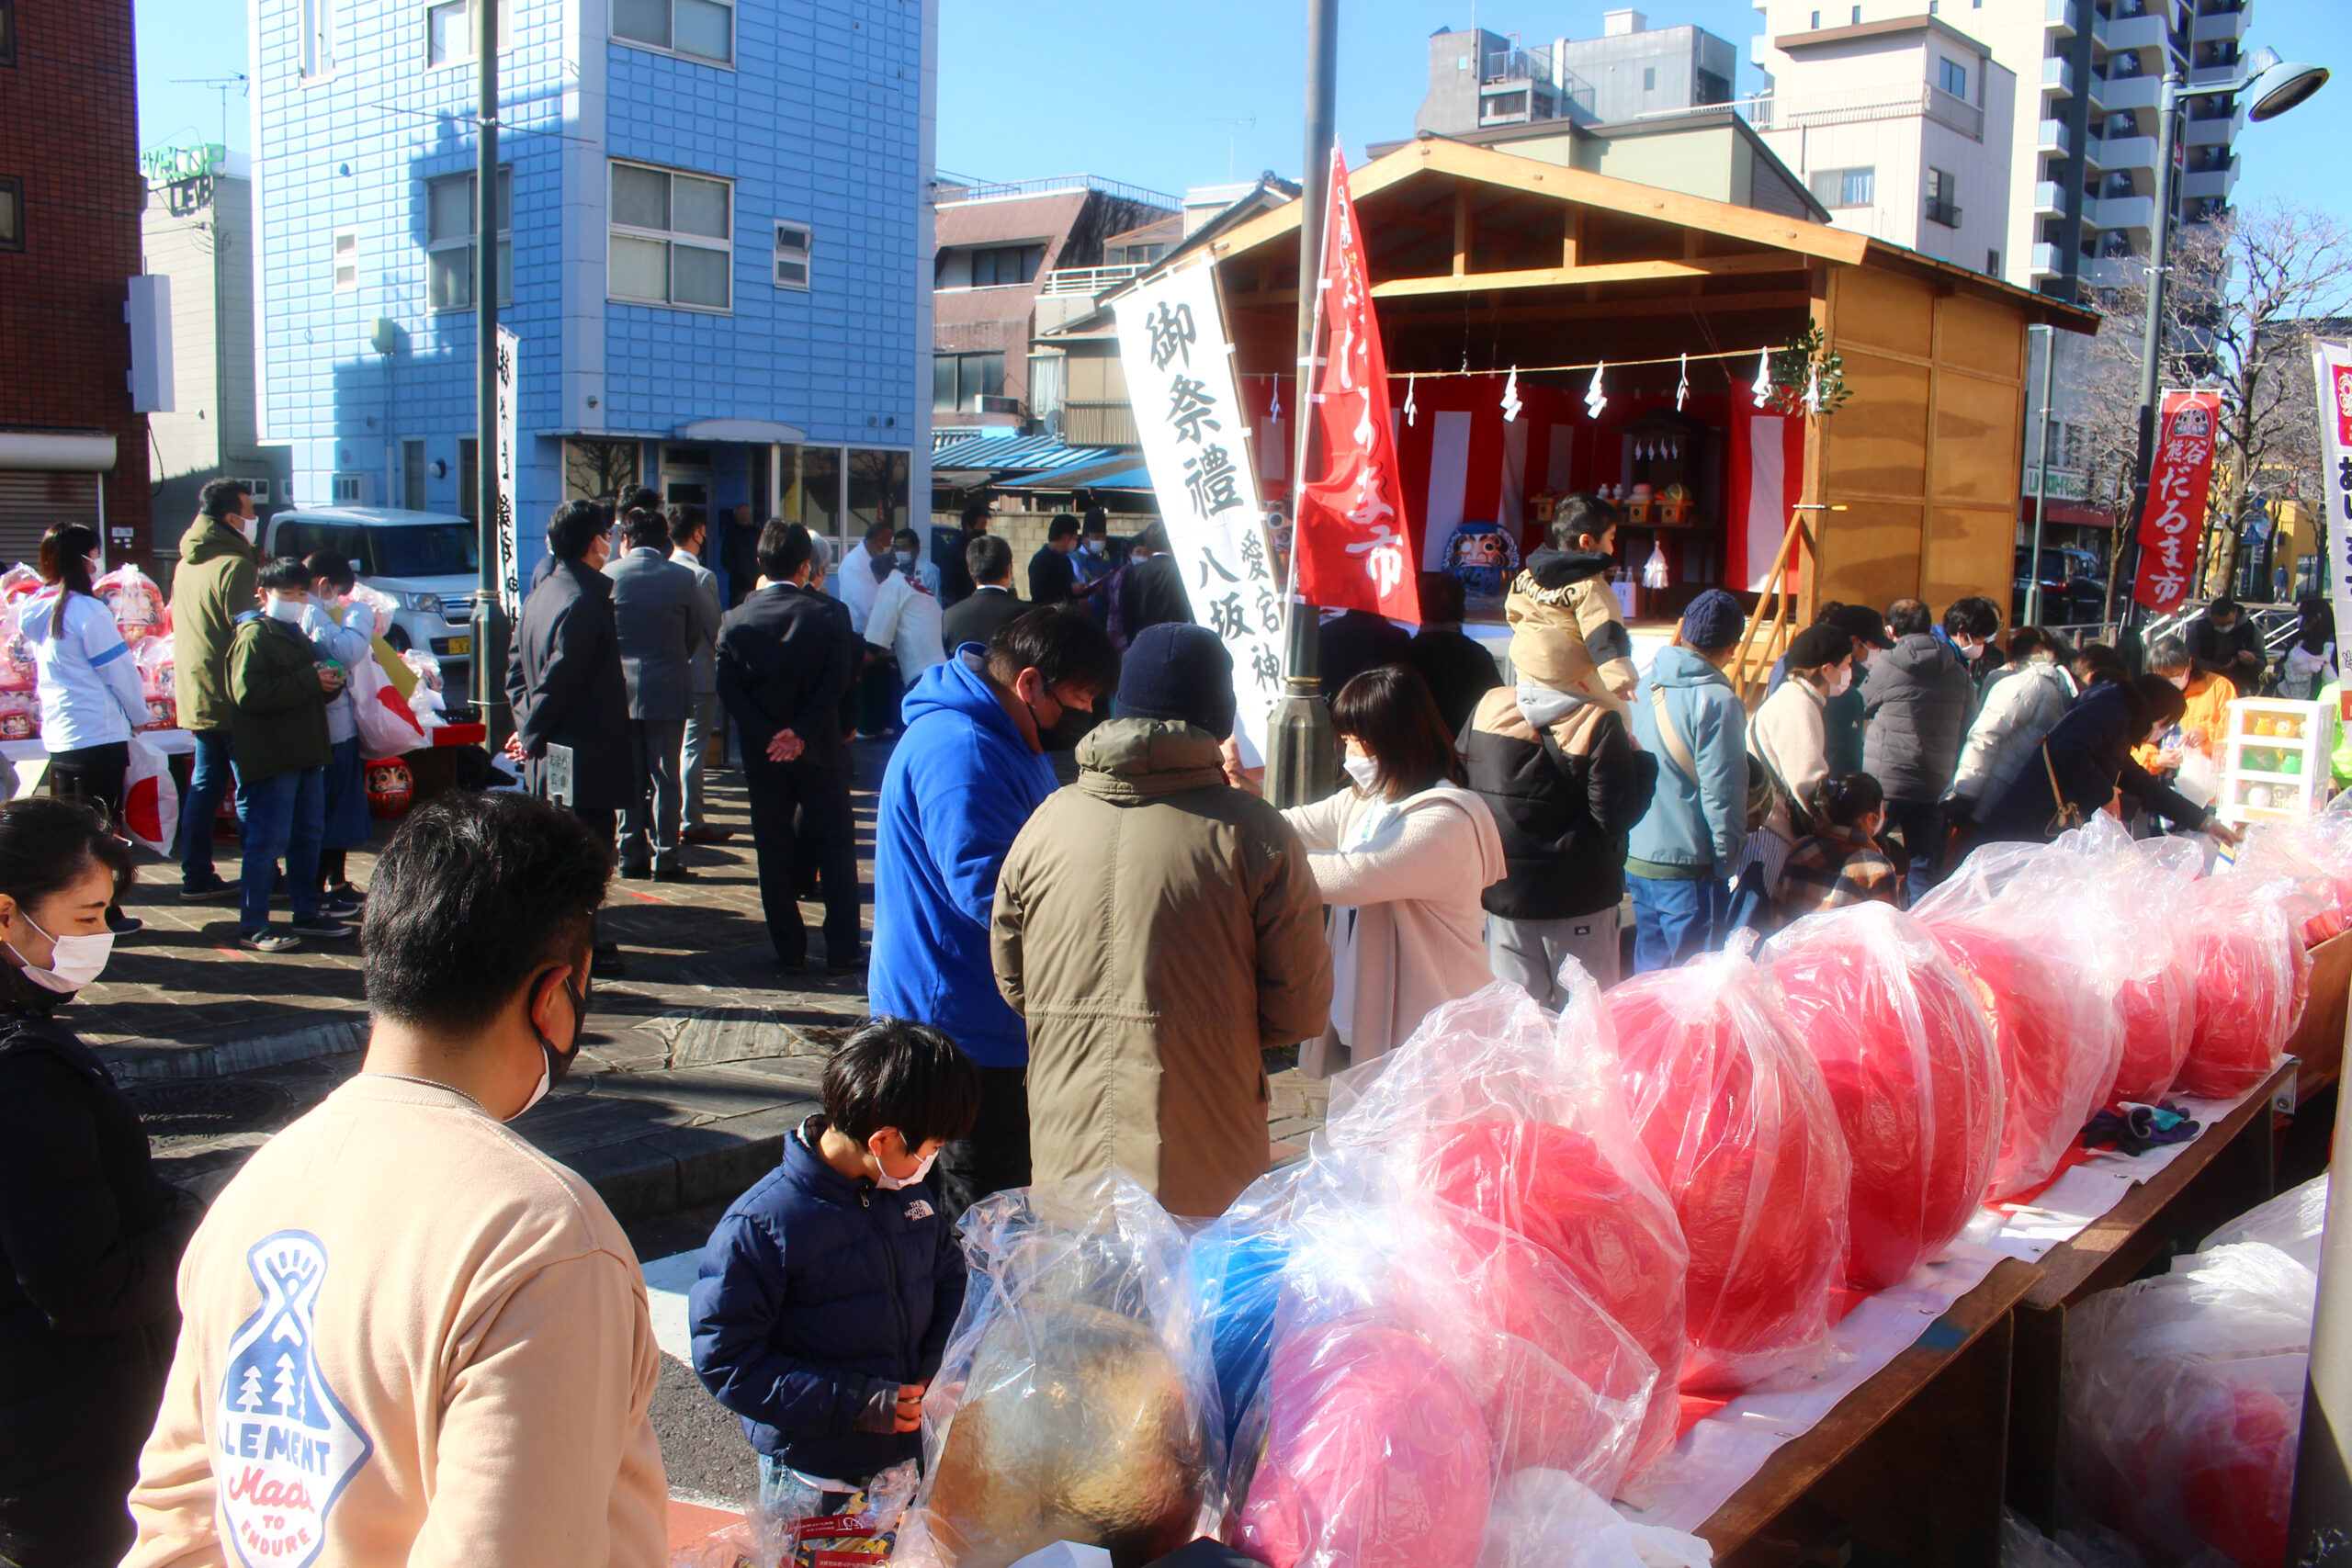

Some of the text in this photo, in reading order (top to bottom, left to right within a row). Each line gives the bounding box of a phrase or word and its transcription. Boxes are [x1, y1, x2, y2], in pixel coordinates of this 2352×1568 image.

[1146, 301, 1244, 521] 御祭禮
[2164, 439, 2207, 465] 熊谷
[2149, 467, 2194, 604] だるま市
[225, 1422, 331, 1476] LEMENT
[241, 1519, 311, 1557] ENDURE
[263, 1515, 285, 1530] TO
